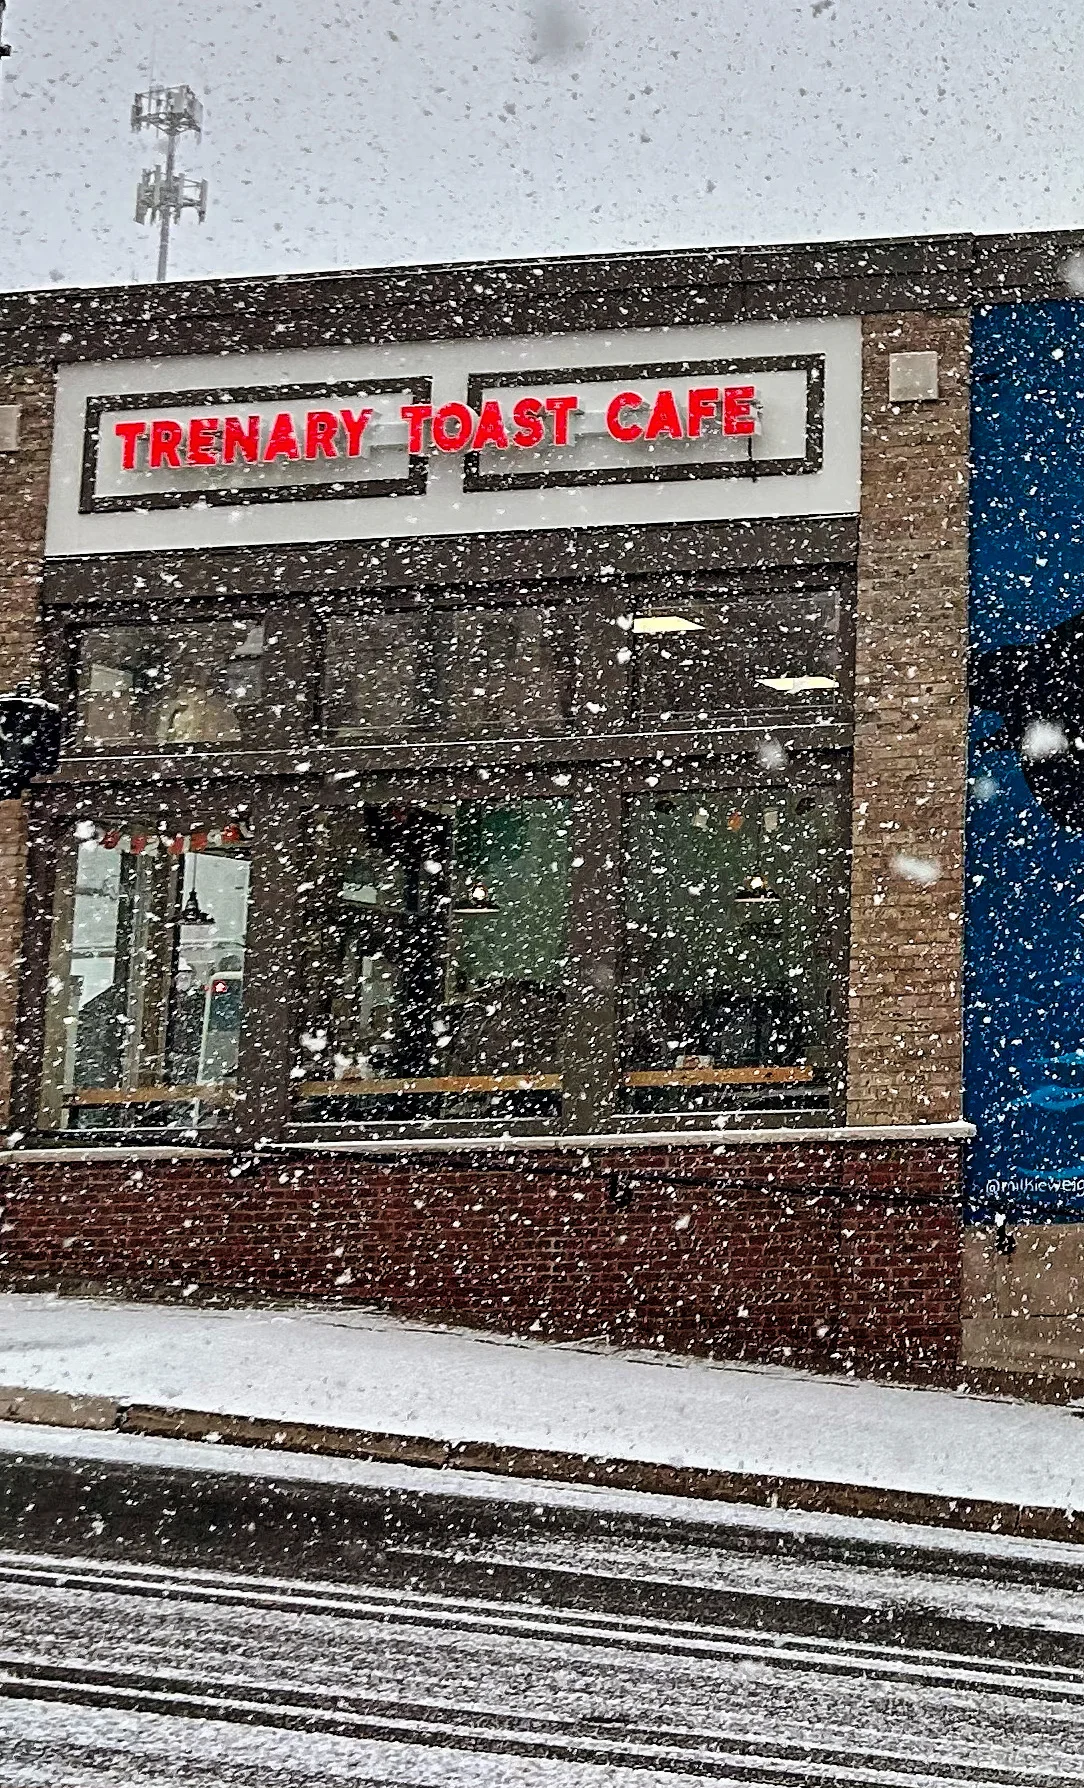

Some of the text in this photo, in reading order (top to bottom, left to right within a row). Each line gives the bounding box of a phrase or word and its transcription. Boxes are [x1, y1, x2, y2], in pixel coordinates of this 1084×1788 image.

[115, 387, 756, 469] TRENARY TOAST CAFE
